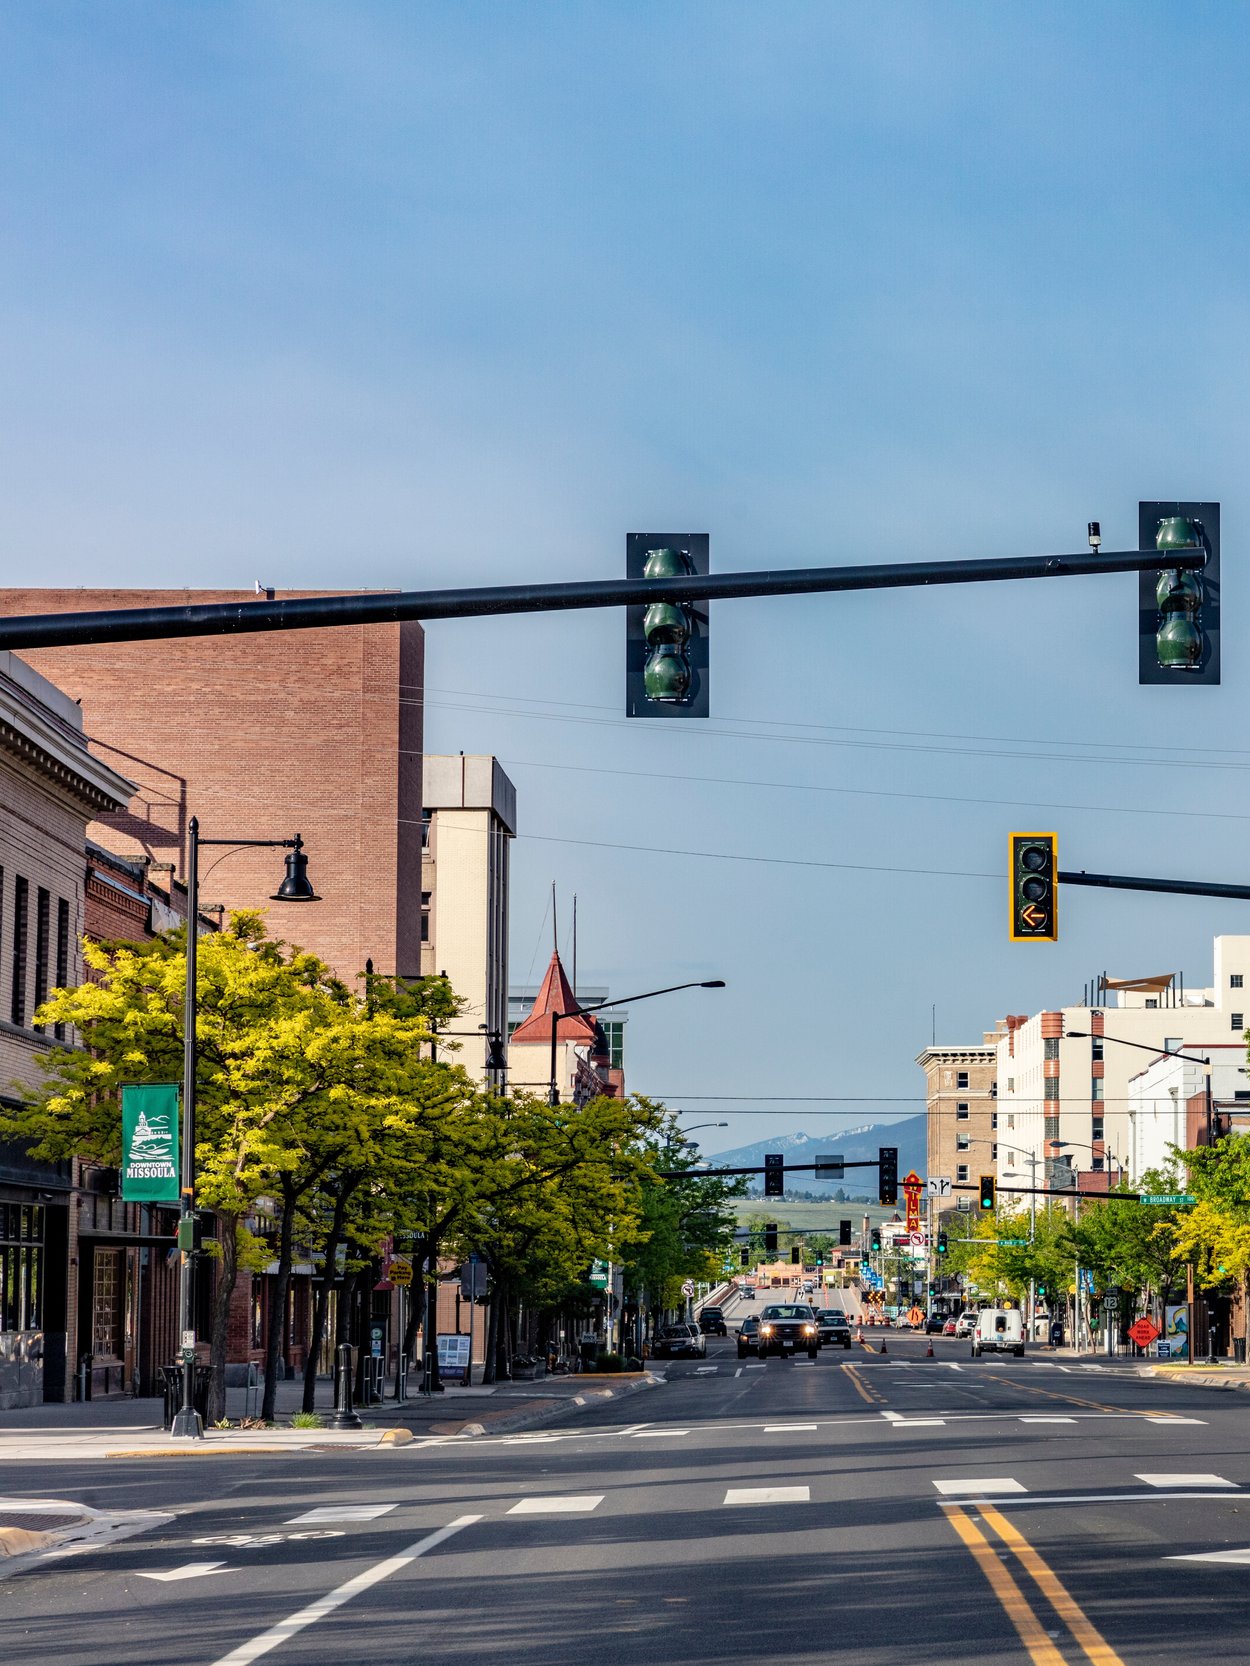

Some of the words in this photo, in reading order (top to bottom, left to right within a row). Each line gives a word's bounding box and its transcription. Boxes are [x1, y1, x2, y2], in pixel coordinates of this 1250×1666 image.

[126, 1167, 176, 1178] MISSOULA
[908, 1185, 918, 1228] WILMA
[1106, 1298, 1116, 1307] 12
